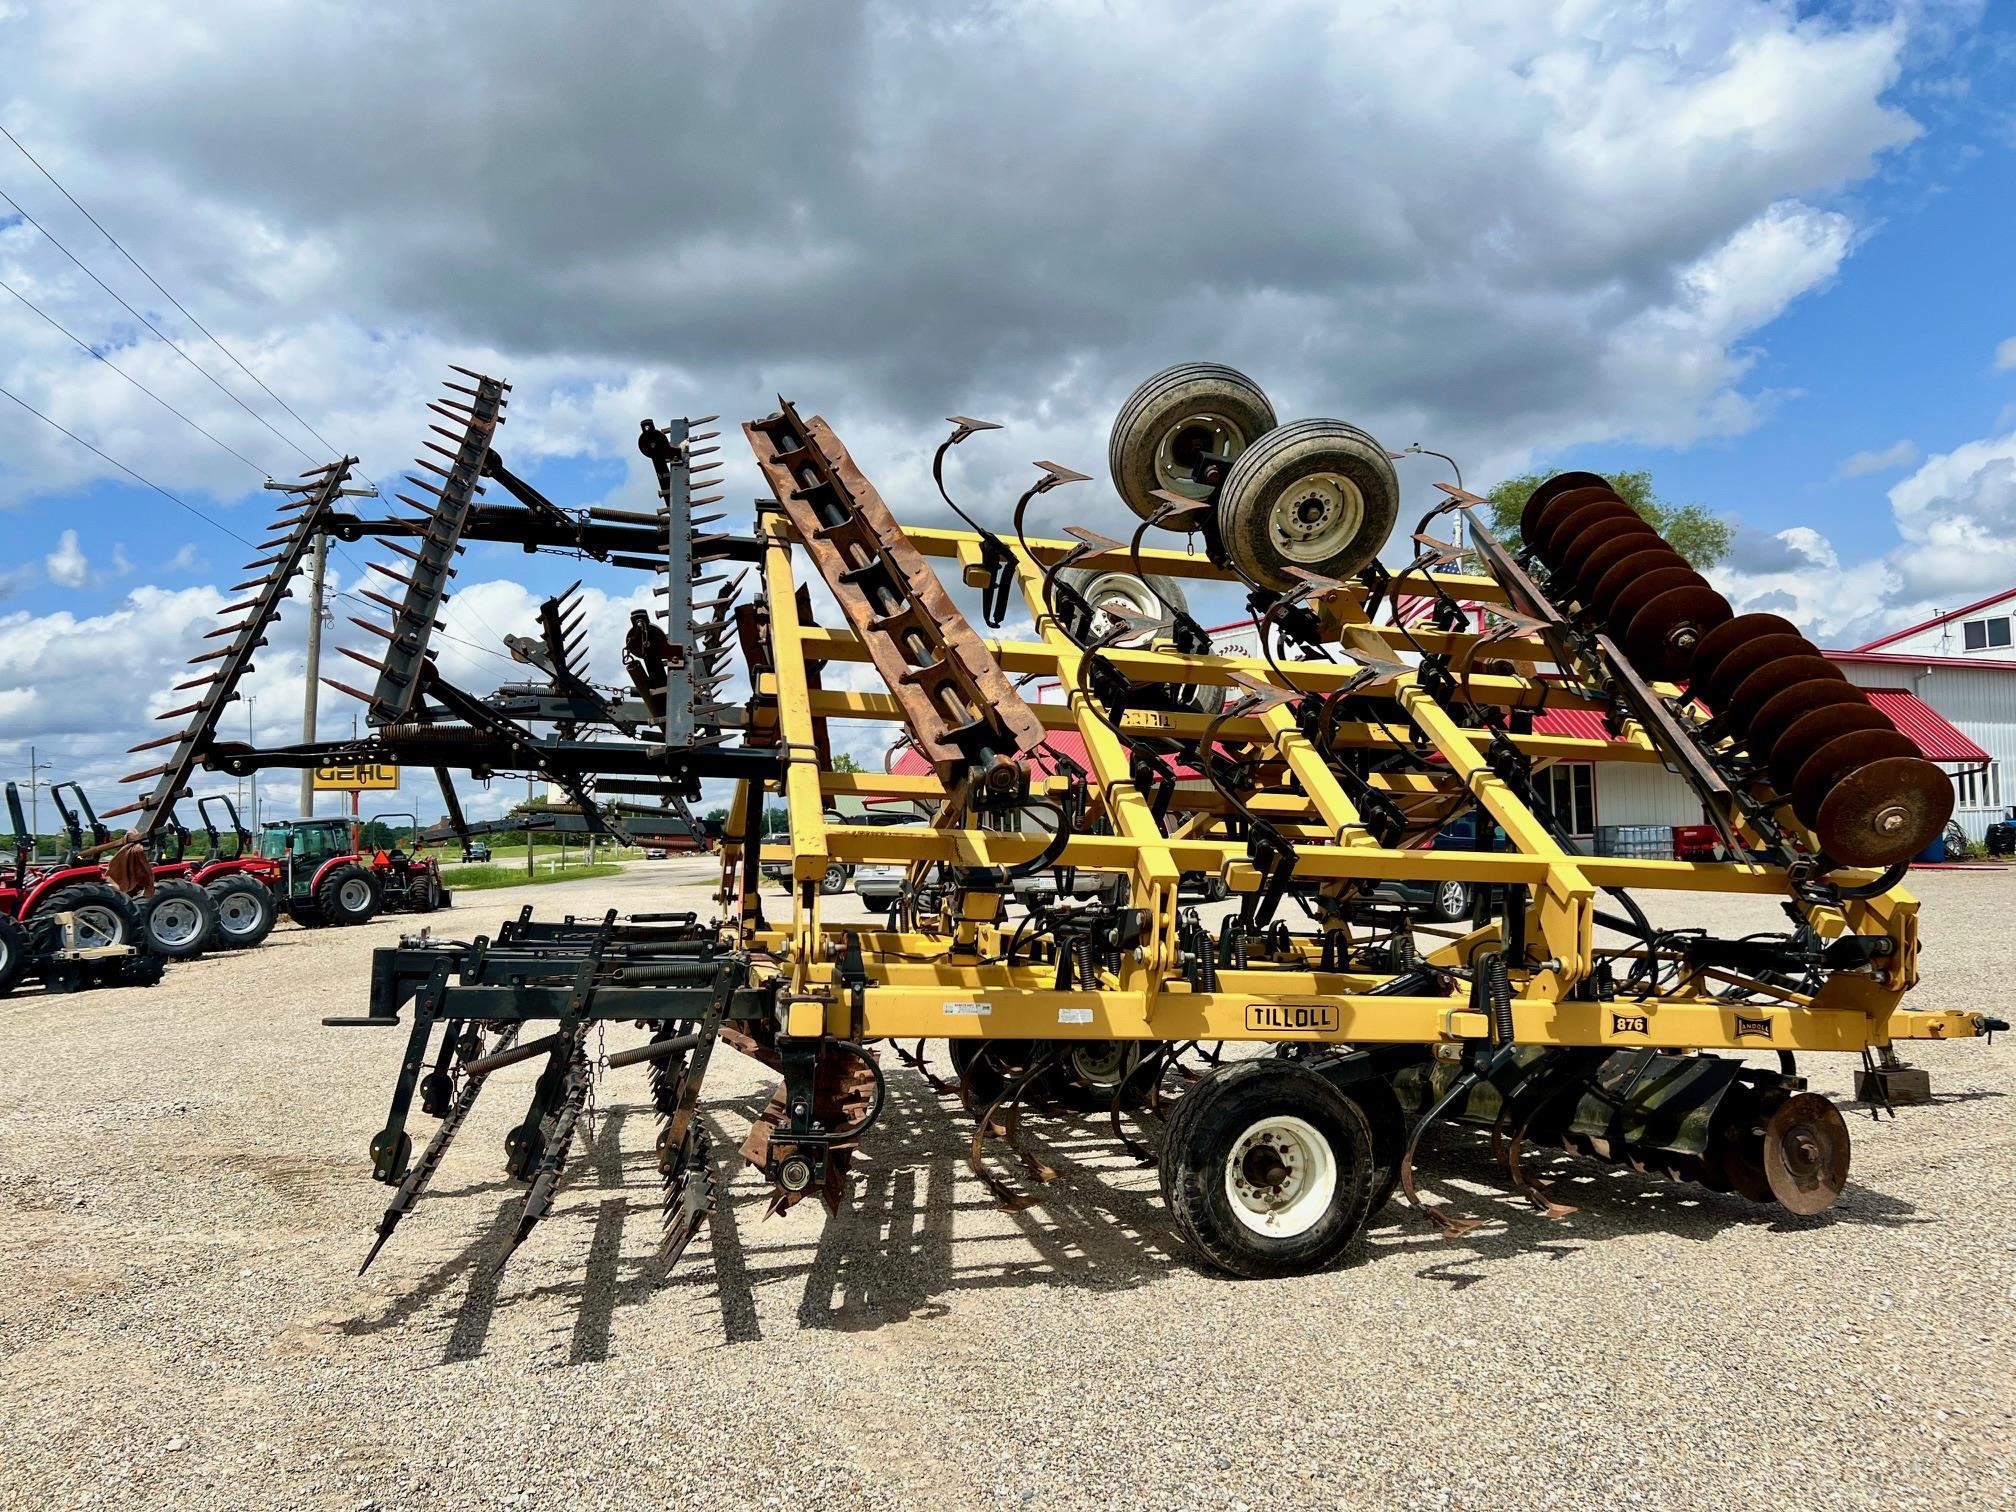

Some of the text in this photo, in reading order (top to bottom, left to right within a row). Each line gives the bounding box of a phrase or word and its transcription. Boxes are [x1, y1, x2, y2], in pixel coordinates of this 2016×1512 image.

[315, 764, 393, 780] GEHL
[1254, 1008, 1331, 1028] TILLOLL
[1616, 1018, 1644, 1031] 876
[1738, 1019, 1770, 1036] LANDOLL
